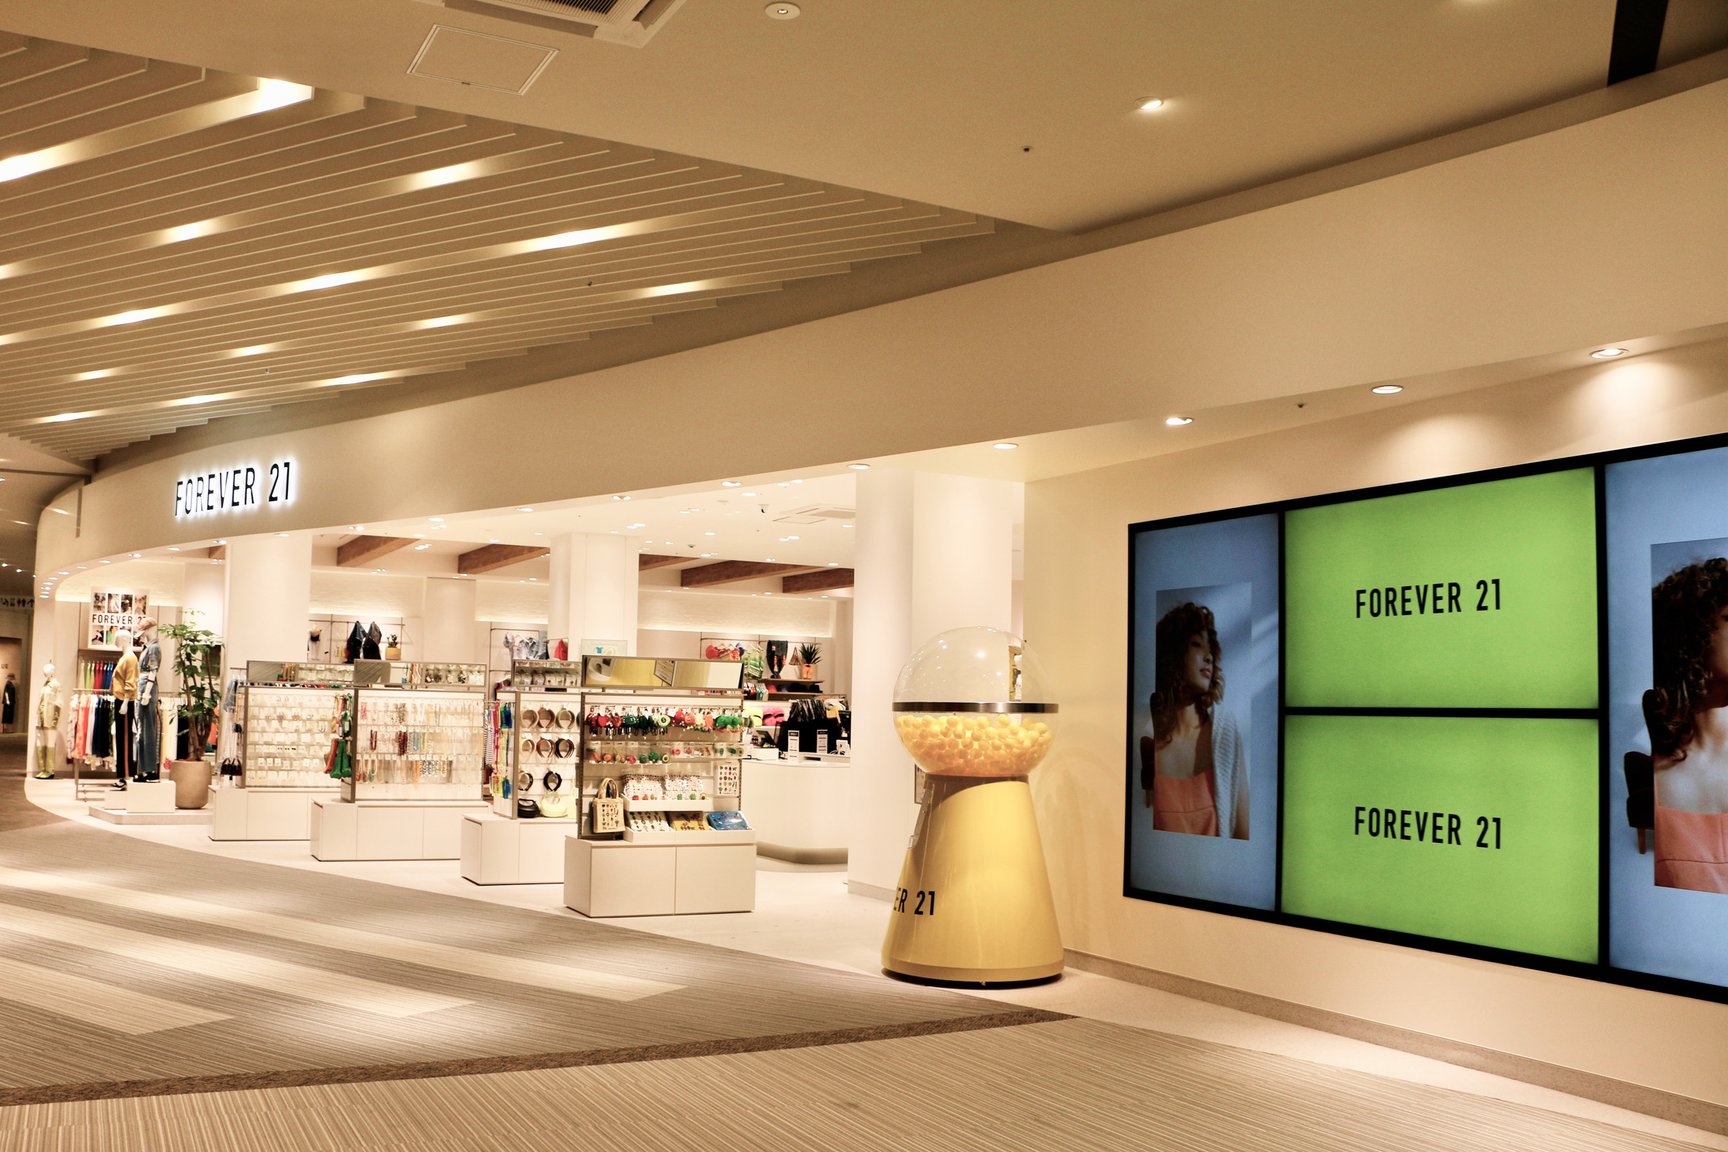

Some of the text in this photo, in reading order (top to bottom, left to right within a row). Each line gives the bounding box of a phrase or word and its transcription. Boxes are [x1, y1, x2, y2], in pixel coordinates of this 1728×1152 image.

[174, 461, 290, 516] FOREVER 21
[1355, 578, 1501, 618] FOREVER 21
[92, 613, 133, 625] FOREVER
[1354, 806, 1502, 850] FOREVER 21
[914, 890, 936, 916] 21
